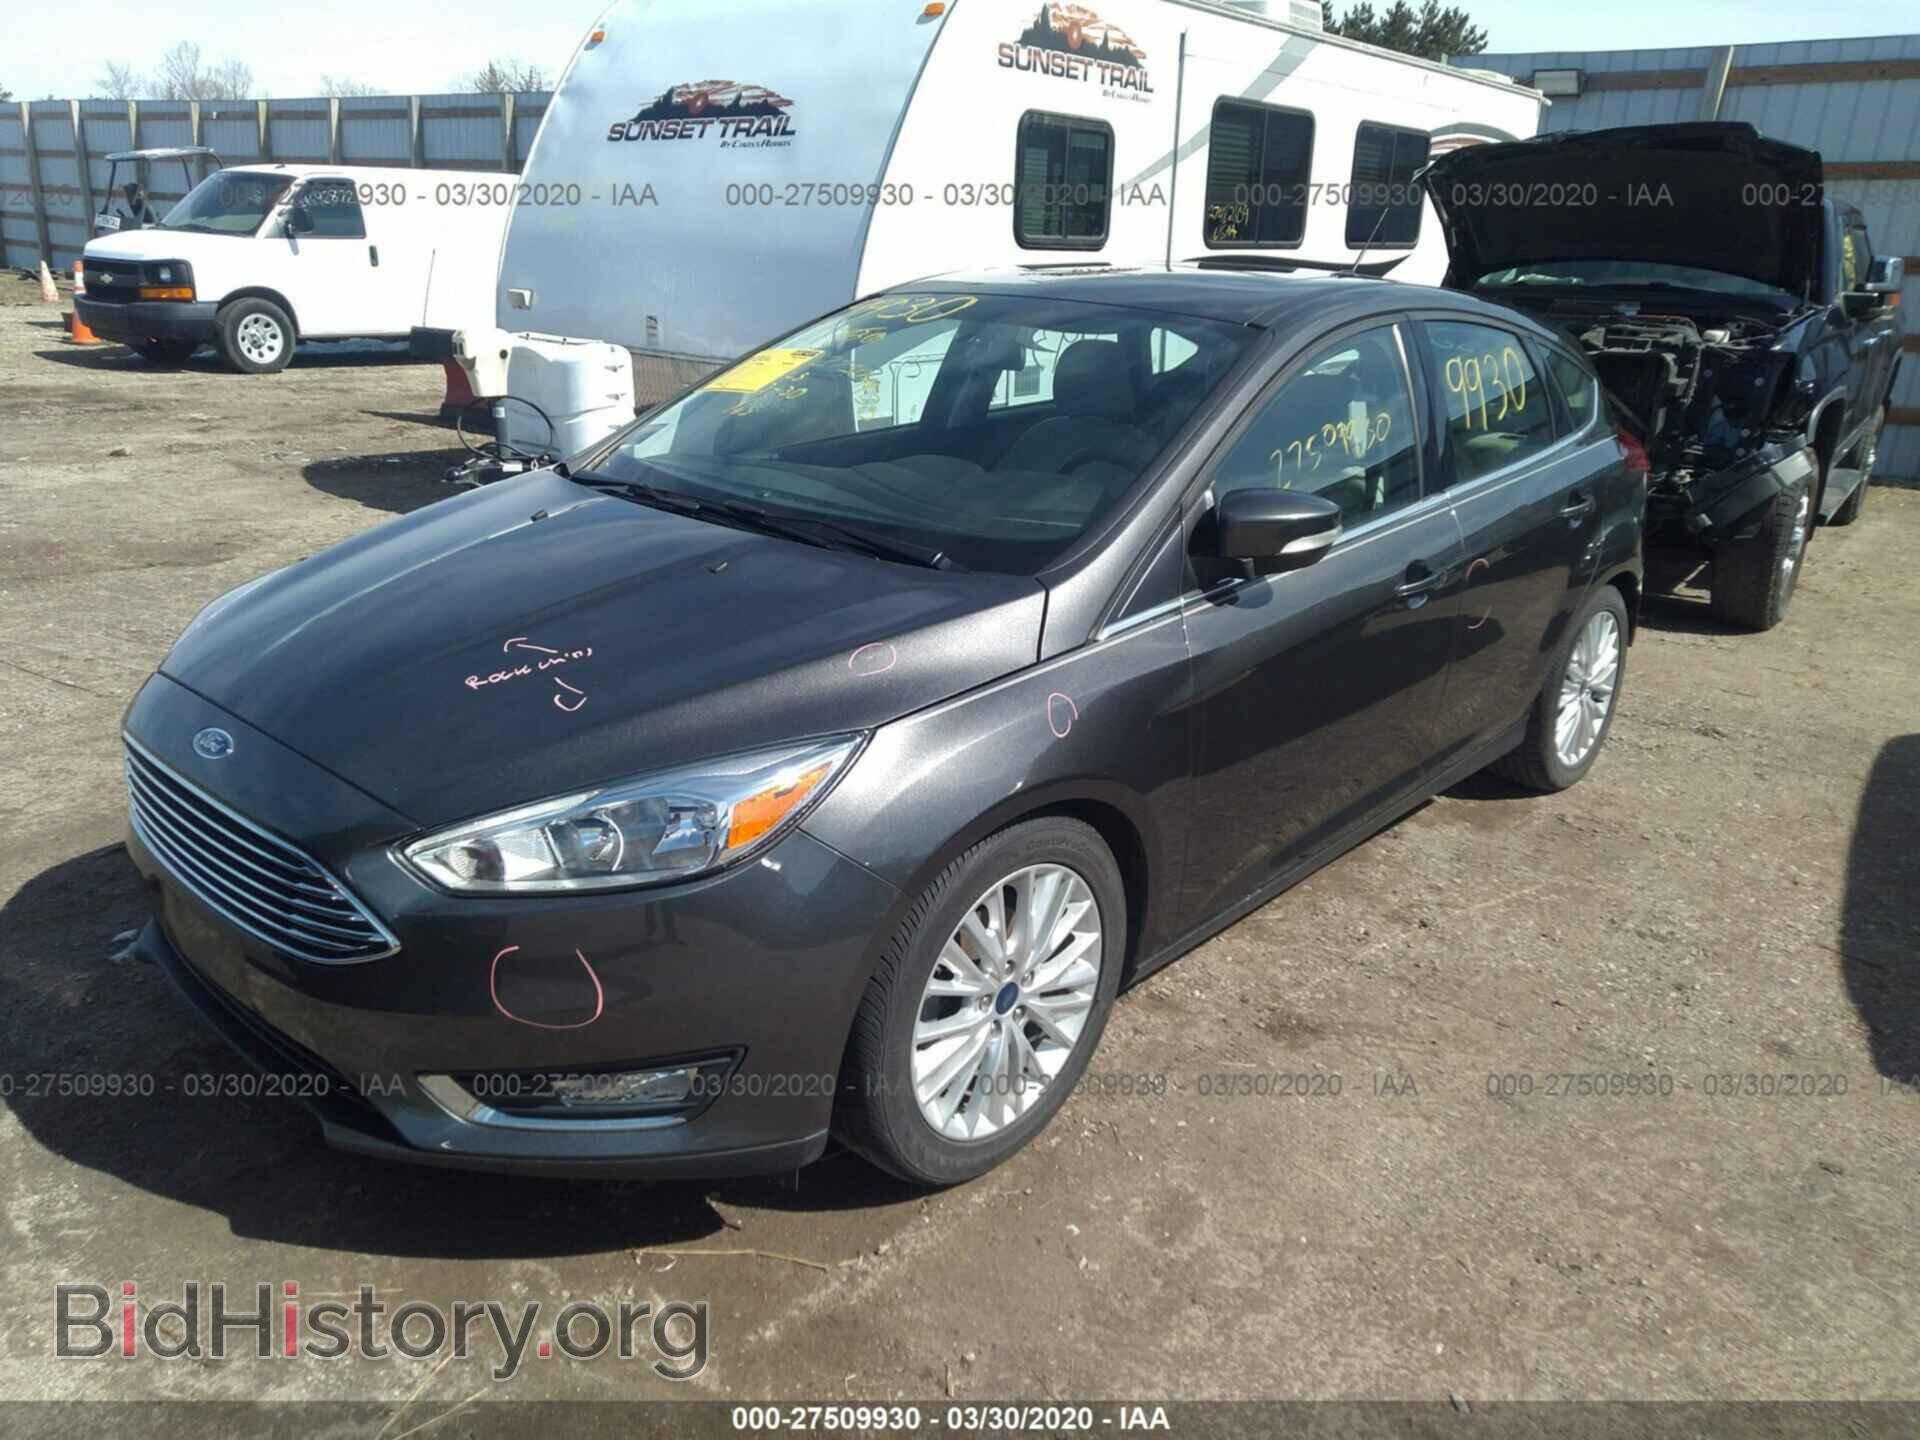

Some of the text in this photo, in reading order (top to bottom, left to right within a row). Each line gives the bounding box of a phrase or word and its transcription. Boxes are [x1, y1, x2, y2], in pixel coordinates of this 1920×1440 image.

[997, 41, 1154, 93] SUNSET TRAIL
[607, 115, 796, 141] SUNSET TRAIL
[1445, 346, 1526, 431] 9930
